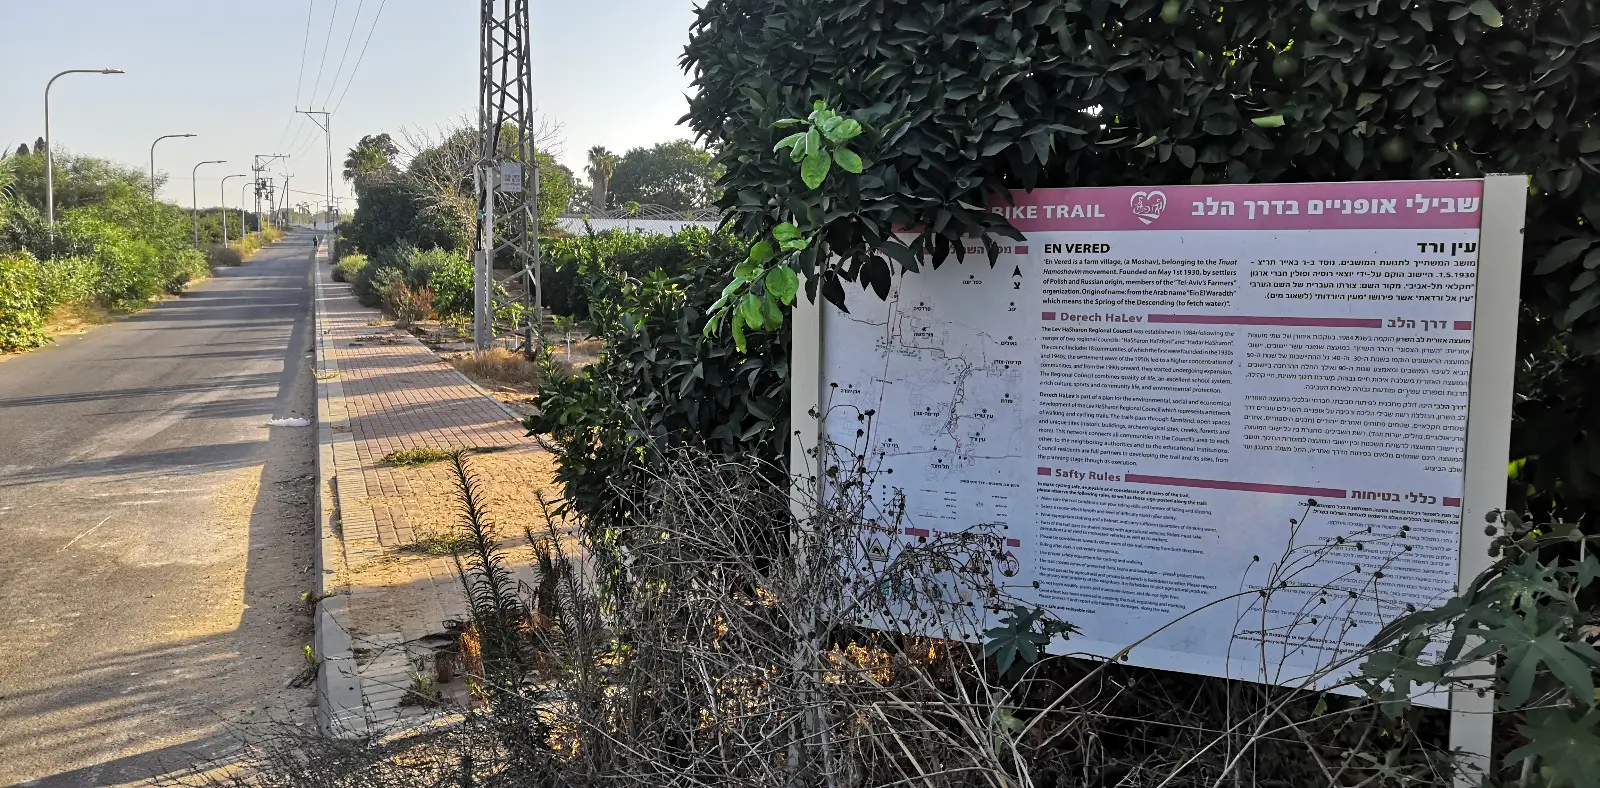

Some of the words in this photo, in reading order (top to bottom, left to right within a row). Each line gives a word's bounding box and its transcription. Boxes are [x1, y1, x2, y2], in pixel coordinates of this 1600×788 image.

[1192, 196, 1234, 216] הלב
[1308, 198, 1397, 215] אופניים
[1406, 194, 1479, 214] שבילי
[992, 206, 1038, 218] BIKE
[1043, 204, 1105, 218] TRAIL
[1244, 200, 1299, 220] בדרך
[1044, 244, 1062, 254] EN
[1066, 244, 1110, 254] VERED
[1417, 242, 1444, 253] ורד
[1452, 242, 1476, 256] עין
[1162, 259, 1195, 267] belonging
[1206, 258, 1216, 266] the
[1414, 260, 1449, 268] המשתייך
[1158, 269, 1171, 277] May
[1203, 269, 1211, 277] by
[1251, 270, 1268, 278] ארגון
[1290, 270, 1309, 278] ופולין
[1357, 270, 1381, 278] על-ידי
[1385, 271, 1404, 279] הוקם
[1043, 277, 1049, 285] of
[1050, 277, 1067, 285] Polish
[1105, 279, 1124, 287] origin,
[1126, 278, 1154, 286] members
[1156, 278, 1162, 286] of
[1163, 278, 1173, 286] the
[1383, 283, 1401, 291] מקור
[1095, 299, 1115, 307] Spring
[1125, 298, 1135, 306] the
[1137, 300, 1174, 308] Descending
[1176, 299, 1185, 307] (to
[1187, 299, 1203, 307] fetch
[1446, 294, 1456, 302] אל
[1060, 312, 1102, 322] Derech
[1106, 314, 1143, 322] HaLev
[1388, 317, 1416, 328] הלב
[1421, 320, 1448, 332] דרך
[1089, 327, 1111, 335] Regional
[1055, 468, 1085, 480] Safty
[1089, 472, 1120, 482] Rules
[1352, 490, 1400, 502] בטיחות
[1404, 491, 1436, 504] כללי
